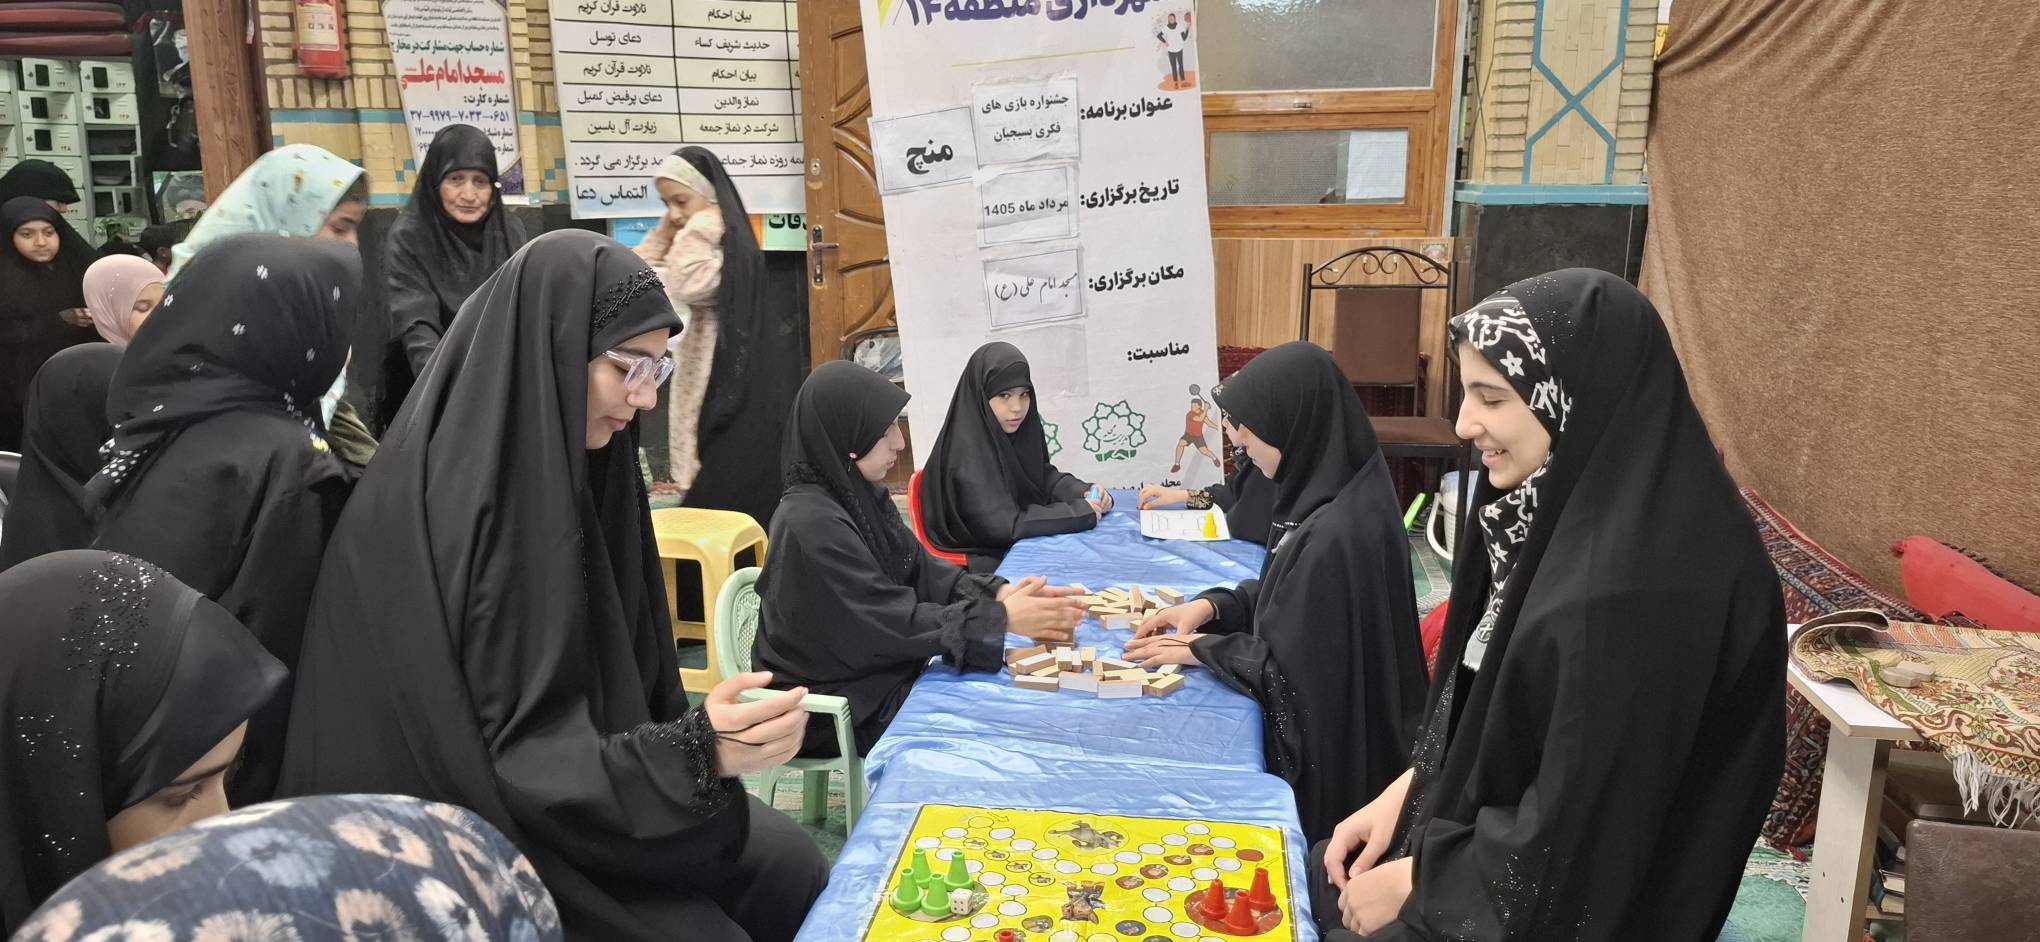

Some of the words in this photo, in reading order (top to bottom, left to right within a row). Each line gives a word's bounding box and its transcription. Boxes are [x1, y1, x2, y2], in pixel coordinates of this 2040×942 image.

[578, 0, 598, 15] کریم
[600, 0, 620, 15] قرآن
[622, 3, 647, 16] تلاوت
[707, 9, 732, 21] احکام
[734, 10, 752, 23] بیان
[589, 30, 616, 46] توسل
[618, 31, 641, 46] دعای
[694, 36, 713, 48] کساء
[716, 38, 741, 53] شریف
[410, 41, 420, 54] در
[420, 40, 447, 54] مشارکت
[448, 41, 465, 54] جهت
[465, 40, 485, 54] حساب
[485, 40, 504, 56] شماره
[742, 41, 770, 52] حدیث
[436, 57, 463, 91] امام
[583, 62, 602, 77] کریم
[604, 60, 625, 77] قرآن
[627, 63, 651, 77] تلاوت
[711, 68, 737, 82] احکام
[739, 69, 757, 82] بیان
[463, 64, 505, 91] مسجد
[488, 93, 511, 107] شماره
[578, 90, 603, 105] کمیل
[606, 90, 637, 106] پرفیض
[639, 91, 662, 104] دعای
[714, 96, 742, 110] والدین
[743, 96, 759, 109] نماز
[1004, 97, 1028, 113] بازی
[1029, 93, 1069, 110] جشنواره
[981, 99, 1002, 114] های
[1080, 100, 1127, 121] برنامه:
[1129, 97, 1173, 118] عنوان
[587, 120, 616, 134] یاسین
[618, 118, 630, 135] آل
[632, 120, 657, 134] زیارت
[699, 124, 723, 135] جمعه
[724, 122, 741, 135] نماز
[743, 125, 752, 135] در
[753, 123, 779, 137] شرکت
[1035, 121, 1061, 139] فکری
[993, 127, 1034, 142] بسیجیان
[603, 159, 621, 170] می
[624, 154, 648, 170] برگزار
[720, 154, 747, 168] جماع
[750, 154, 767, 167] نماز
[770, 156, 788, 168] روزه
[905, 139, 954, 175] منچ
[576, 184, 597, 200] دعا
[600, 184, 648, 206] التماس
[1080, 183, 1137, 209] برگزاری:
[1139, 178, 1180, 204] تاریخ
[984, 202, 1015, 216] 1405
[1018, 200, 1036, 213] ماه
[1038, 198, 1069, 212] مرداد
[1088, 268, 1146, 292] برگزاری:
[1147, 264, 1185, 286] مکان
[994, 281, 1018, 301] (ع)
[1019, 273, 1035, 298] علی
[1039, 275, 1056, 305] امام
[1057, 272, 1079, 298] مسجد
[1127, 342, 1190, 363] مناسبت:
[1160, 478, 1181, 488] محل
